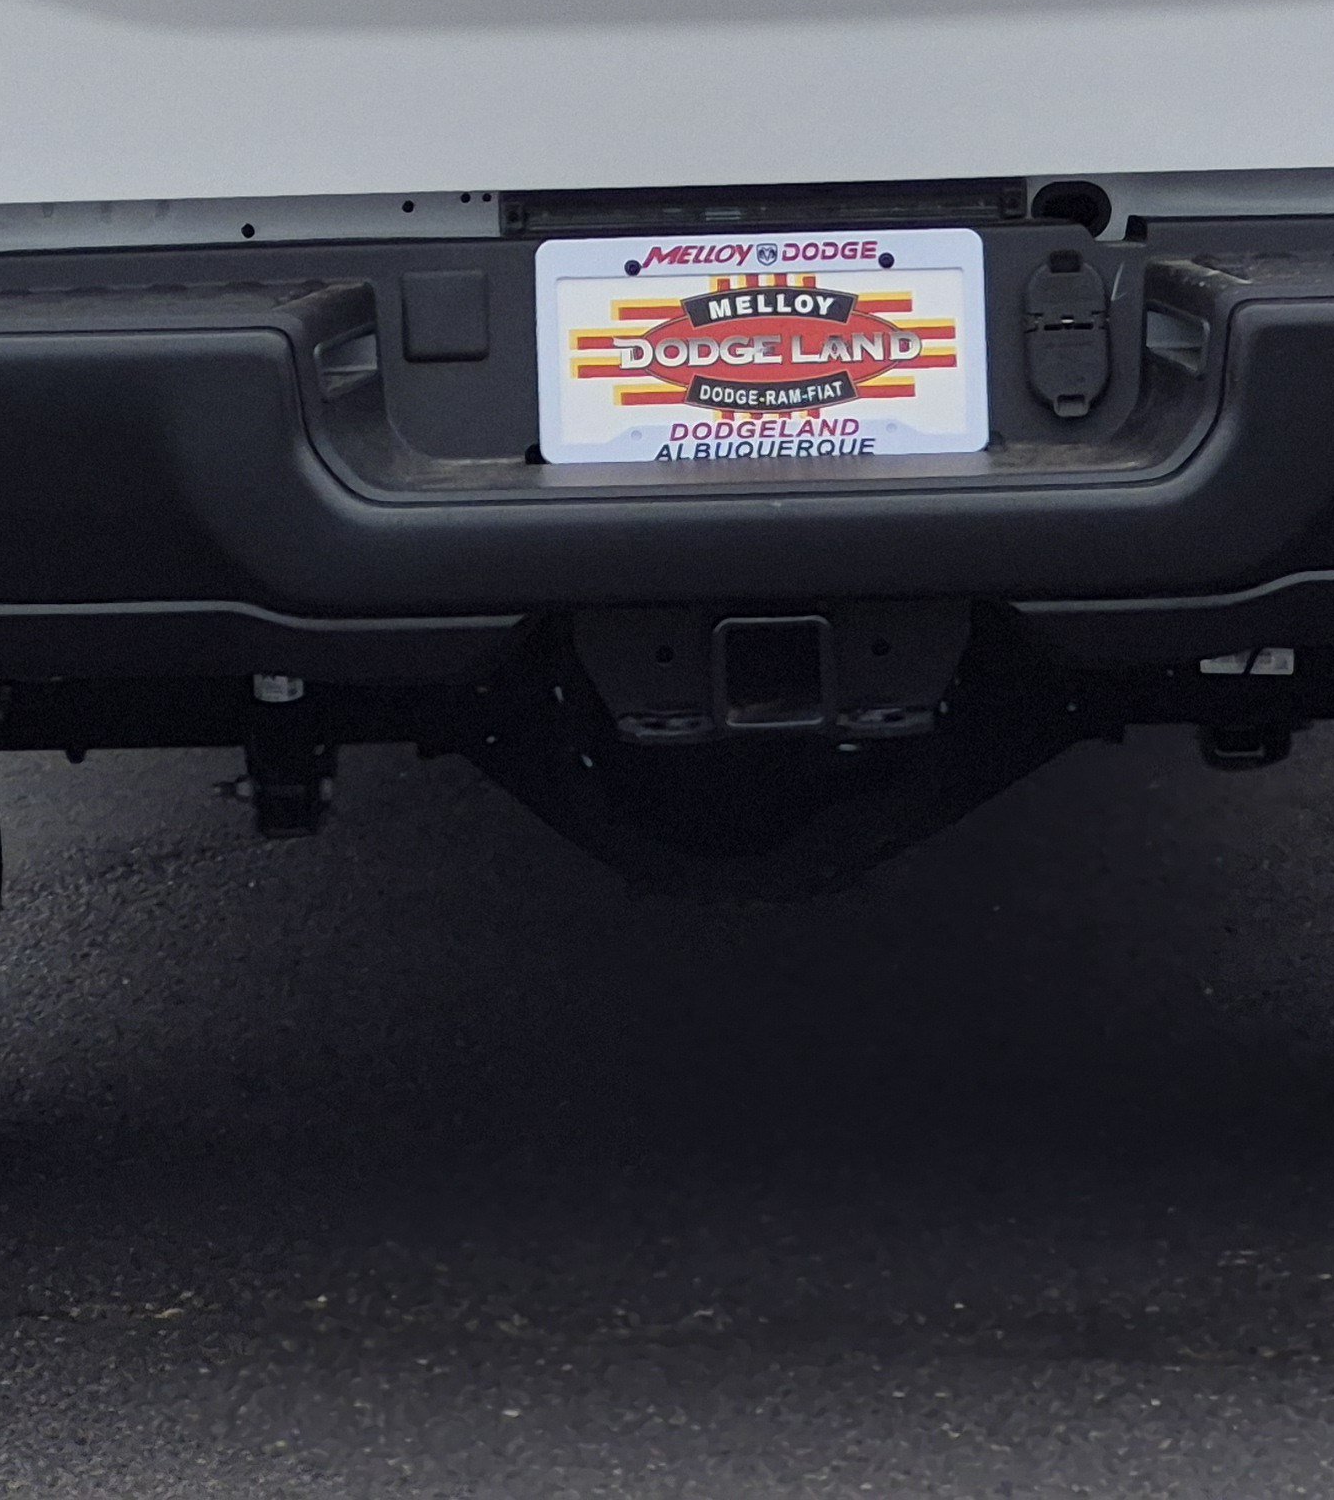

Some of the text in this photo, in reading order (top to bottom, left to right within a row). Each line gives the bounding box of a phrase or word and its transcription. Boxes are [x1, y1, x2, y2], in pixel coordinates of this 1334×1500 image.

[641, 240, 878, 268] MELLOY DODGE
[708, 294, 835, 320] MELLOY
[699, 380, 843, 407] DODGE-RAM-FIAT
[669, 418, 860, 442] DODGELAND
[654, 438, 876, 462] ALBUQUERQUE
